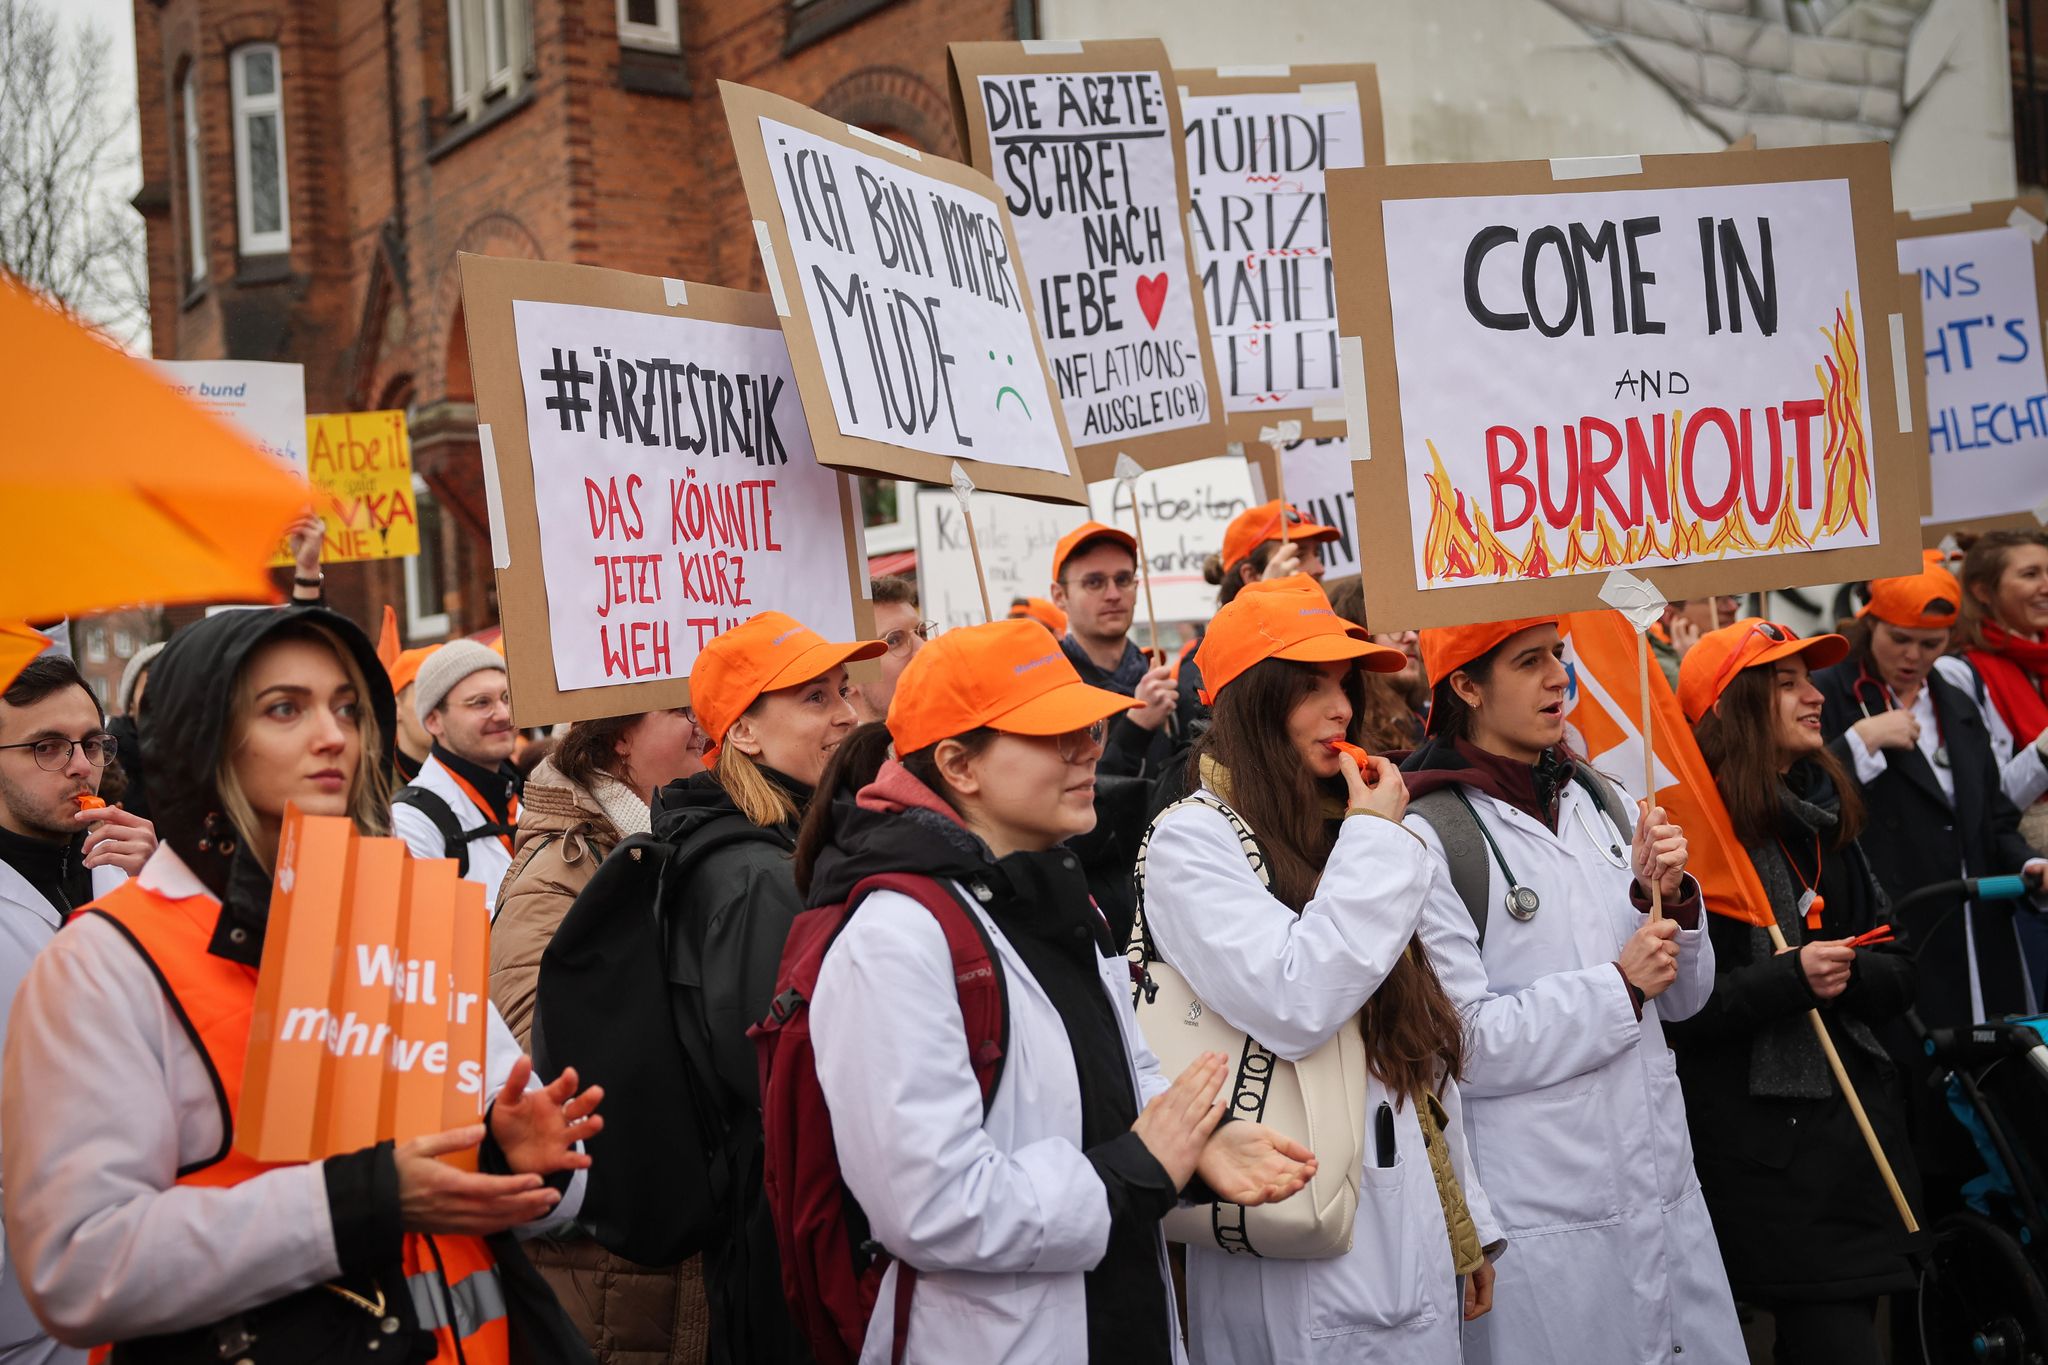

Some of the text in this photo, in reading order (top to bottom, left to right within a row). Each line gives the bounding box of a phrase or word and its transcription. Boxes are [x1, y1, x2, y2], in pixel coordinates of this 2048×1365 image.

[983, 74, 1163, 132] DIE ÄRZTE:
[1004, 140, 1133, 219] SCHREI
[1082, 205, 1166, 270] NACH
[1040, 270, 1124, 340] IEBE
[1463, 215, 1778, 338] COME IN
[1917, 260, 1981, 301] NS
[811, 263, 973, 449] MÜDE
[1924, 313, 2030, 376] HT'S
[199, 381, 247, 398] bund
[540, 345, 788, 466] #ÄRZTESTREIK
[1083, 380, 1207, 437] AUSGLEICH)
[1615, 368, 1690, 399] AND
[1929, 393, 2048, 455] HLECHT
[1485, 399, 1826, 533] BURNOUT
[584, 466, 783, 553] DAS KÖNNTE
[594, 550, 752, 618] JETZT KURZ
[599, 618, 672, 680] WEH
